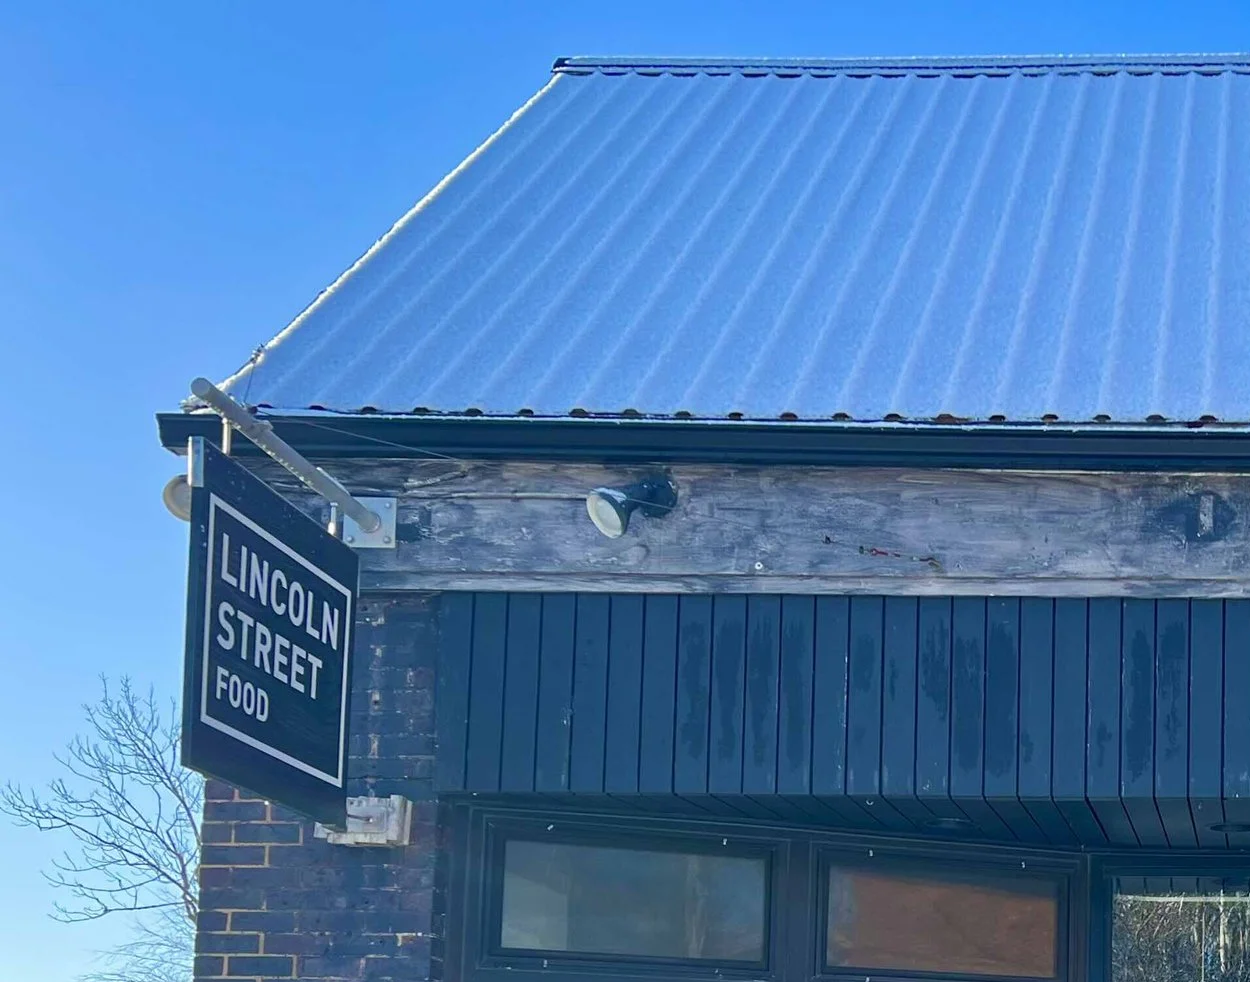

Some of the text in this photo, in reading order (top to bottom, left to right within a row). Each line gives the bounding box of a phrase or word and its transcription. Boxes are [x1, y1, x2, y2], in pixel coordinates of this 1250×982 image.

[221, 533, 339, 650] LINCOLN
[216, 601, 323, 699] STREET
[216, 666, 269, 722] FOOD
